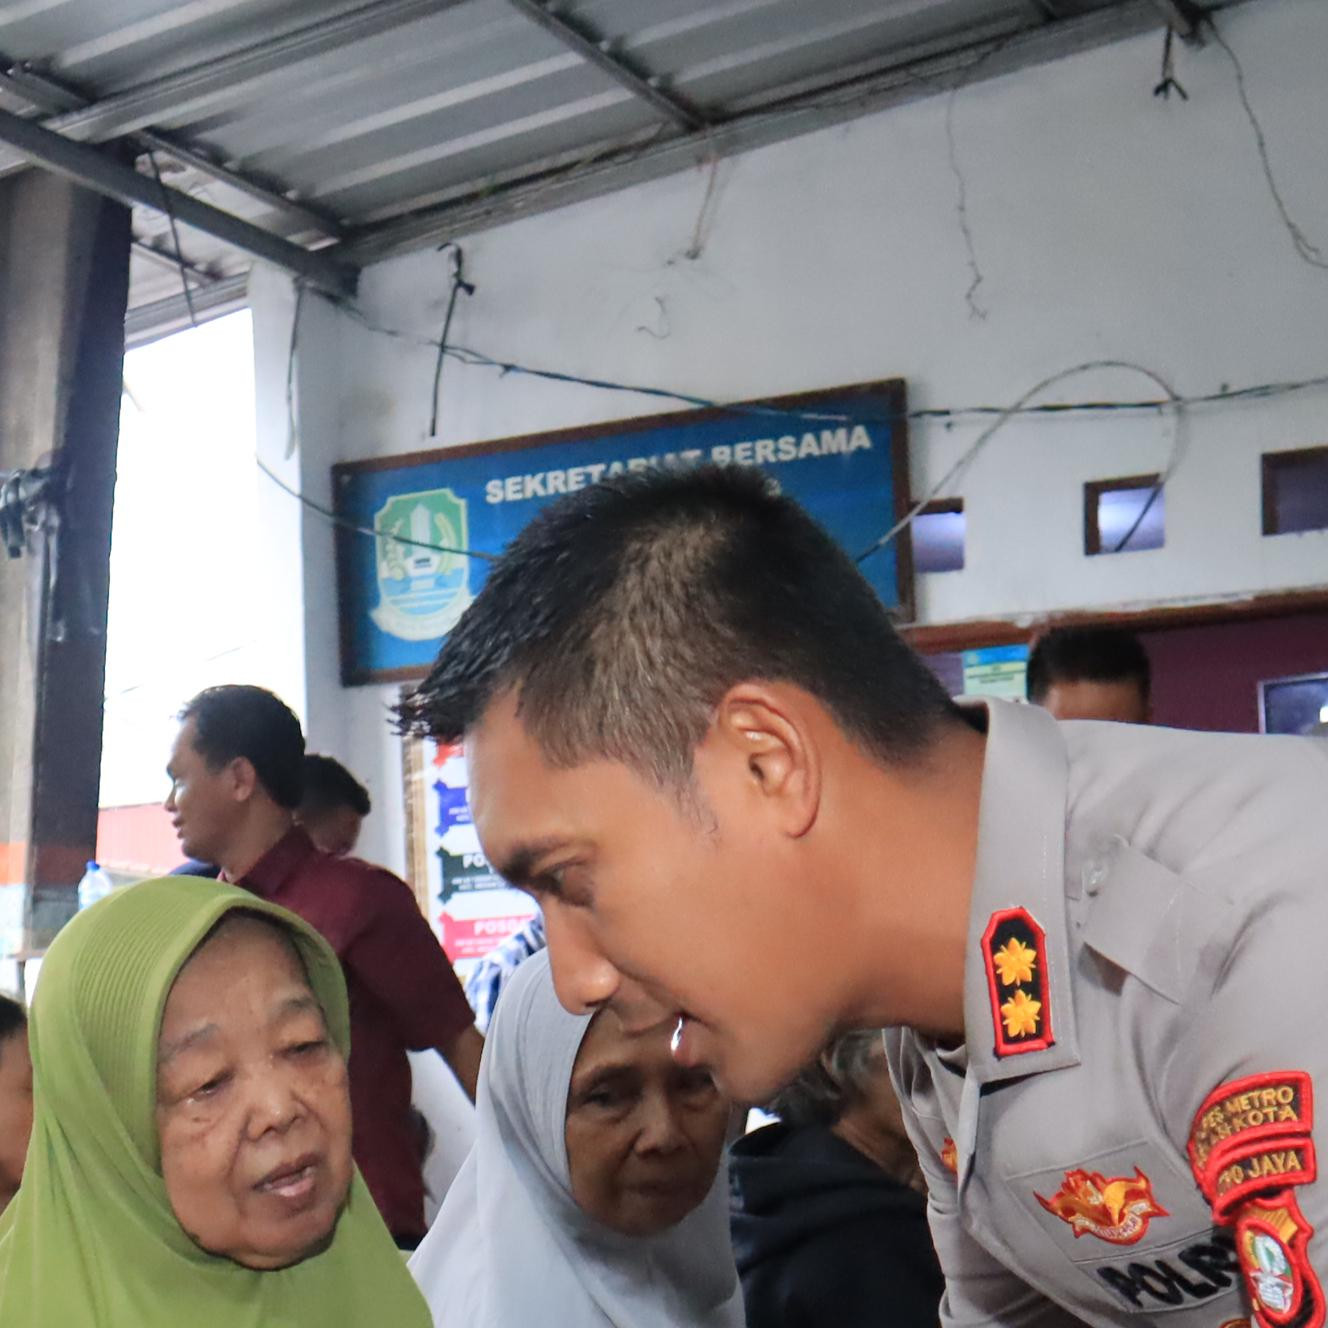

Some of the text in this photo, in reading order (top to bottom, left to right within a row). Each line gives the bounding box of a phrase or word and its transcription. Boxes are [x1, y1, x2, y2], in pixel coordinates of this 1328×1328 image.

[710, 424, 872, 470] BERSAMA
[1225, 1085, 1294, 1114] METRO
[1232, 1104, 1299, 1132] KOTA
[1247, 1149, 1302, 1179] JAYA
